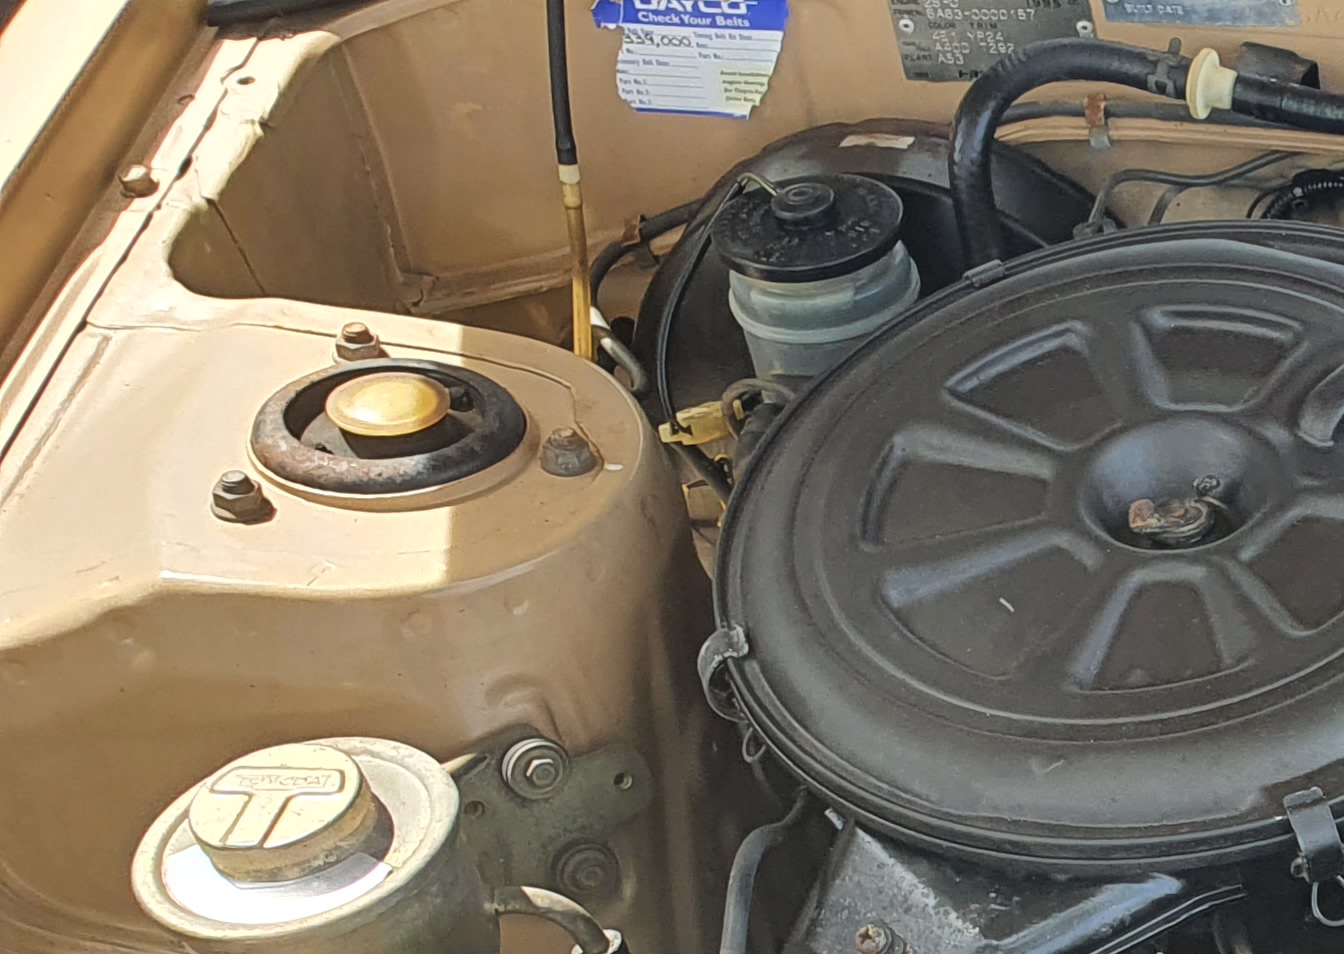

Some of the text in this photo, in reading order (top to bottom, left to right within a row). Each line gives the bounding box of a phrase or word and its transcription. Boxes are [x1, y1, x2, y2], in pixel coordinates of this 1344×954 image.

[638, 12, 750, 27] Check Your Belts
